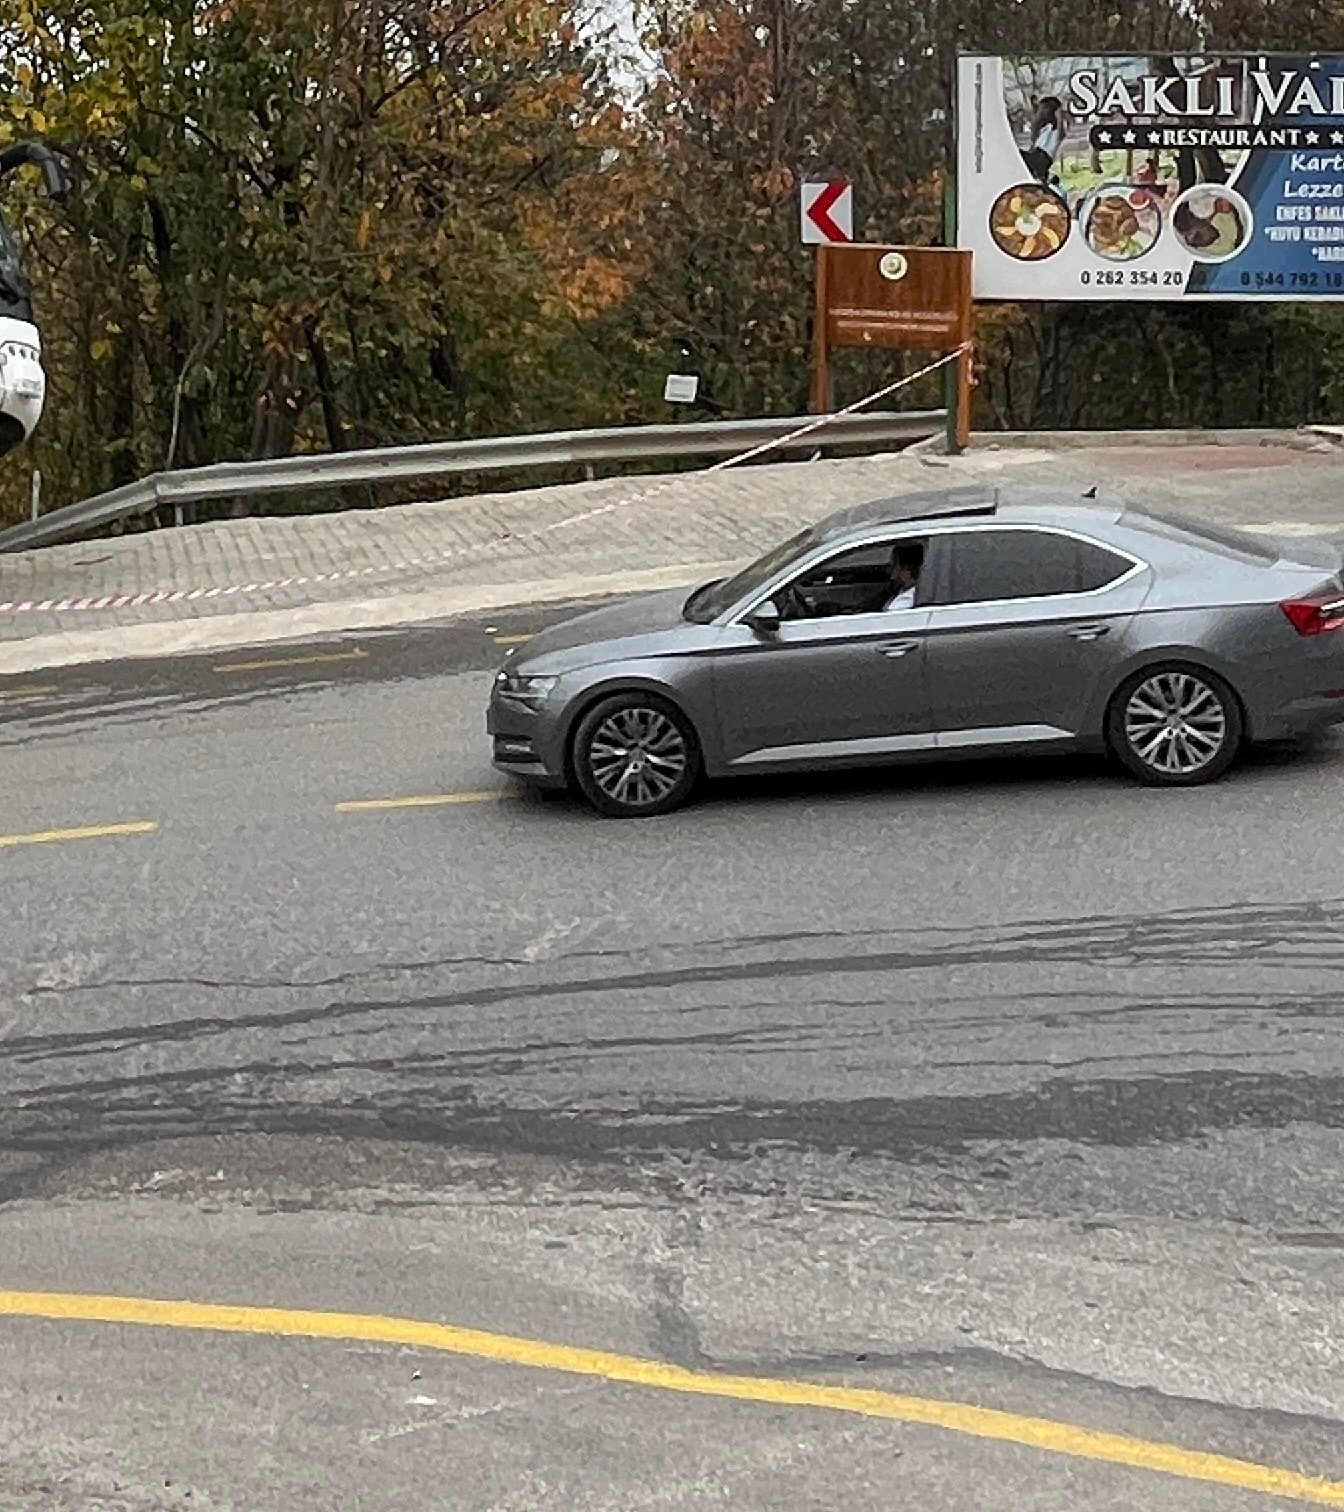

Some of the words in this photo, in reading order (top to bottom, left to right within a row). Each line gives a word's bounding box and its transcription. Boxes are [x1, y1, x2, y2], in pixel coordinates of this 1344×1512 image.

[1068, 70, 1236, 117] SAKLI
[1163, 128, 1302, 146] RESTAURANT
[1080, 271, 1091, 285] 0
[1096, 271, 1124, 285] 262
[1129, 271, 1158, 285] 354
[1163, 271, 1184, 285] 20
[1240, 272, 1251, 286] 0
